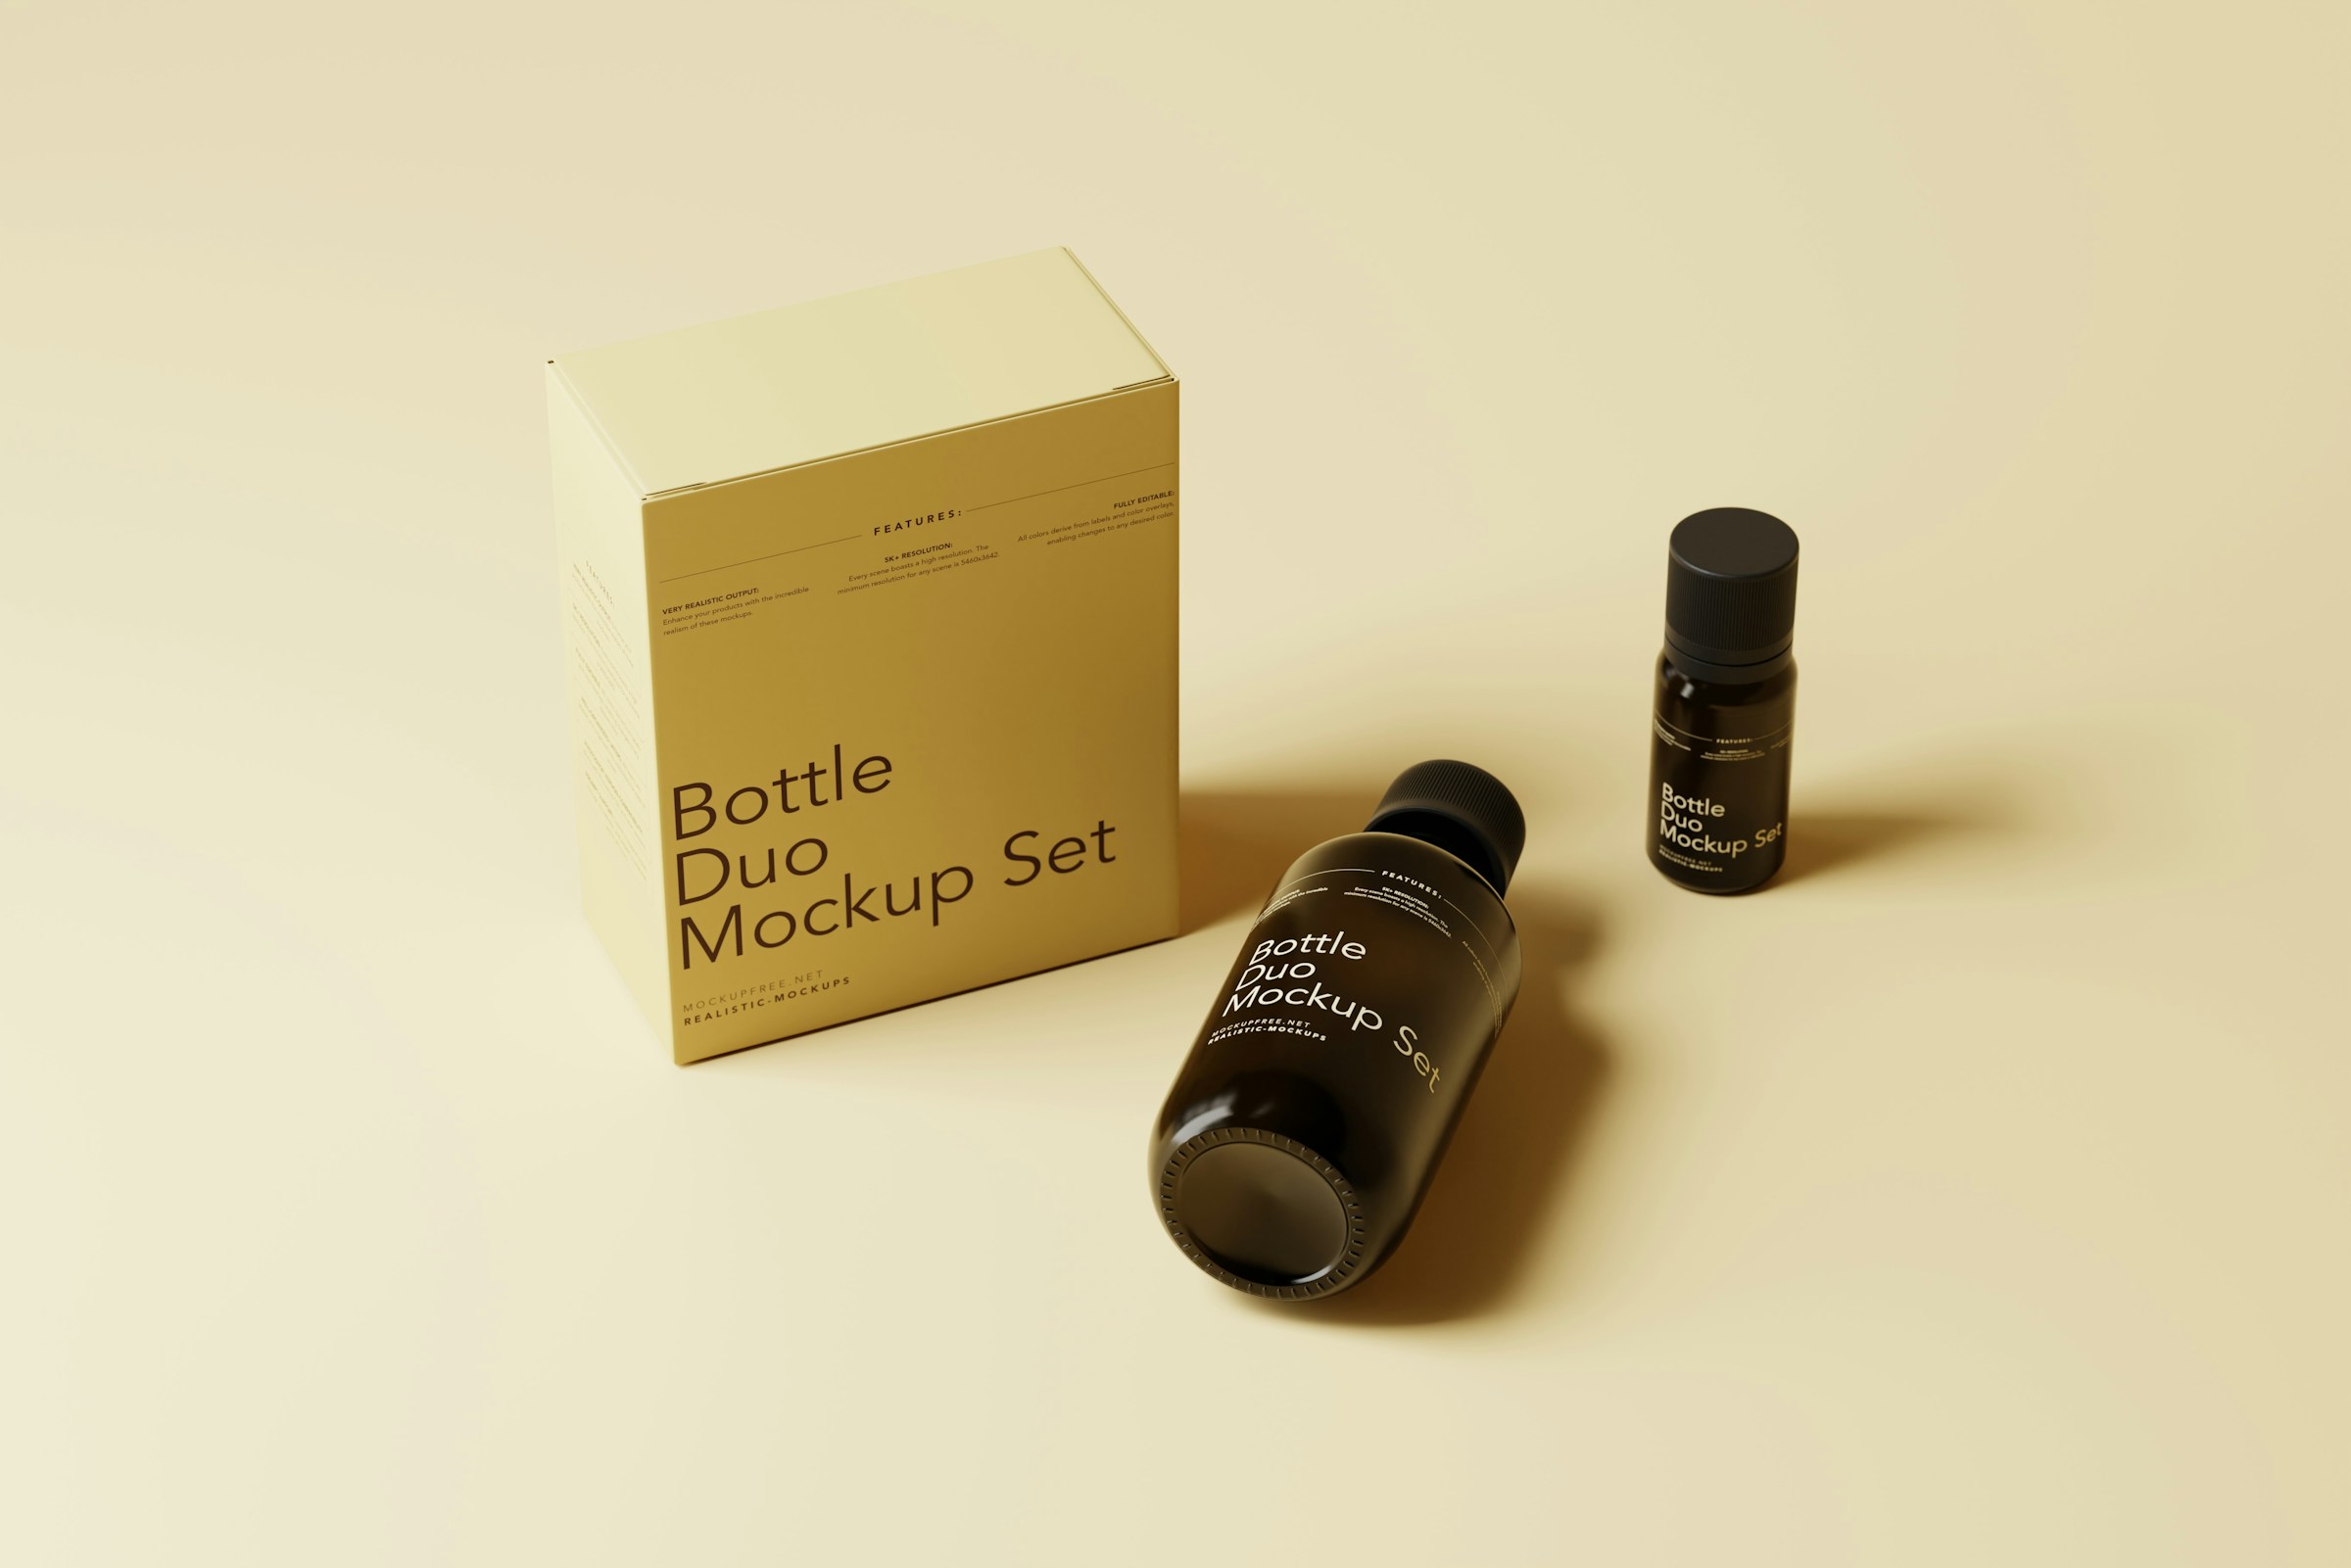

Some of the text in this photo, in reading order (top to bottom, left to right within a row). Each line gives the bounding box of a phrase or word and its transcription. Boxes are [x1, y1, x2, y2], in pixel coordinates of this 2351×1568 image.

[1114, 490, 1175, 509] FULLY EDITABLE:
[874, 509, 962, 536] FEATURES:
[1029, 530, 1049, 541] colors
[1051, 525, 1072, 535] derive
[1074, 521, 1089, 530] from
[1091, 515, 1111, 526] labels
[1127, 508, 1144, 517] color
[1046, 534, 1077, 546] enabling
[1078, 528, 1106, 539] changes
[1129, 515, 1155, 526] desired
[901, 543, 953, 559] RESOLUTION:
[838, 583, 870, 594] minimum
[871, 575, 905, 587] resolution
[918, 568, 931, 577] any
[933, 564, 952, 573] scene
[848, 573, 868, 583] Every
[869, 568, 889, 578] scene
[890, 562, 914, 573] boasts
[921, 556, 936, 565] high
[662, 588, 759, 615] VERY REALISTIC OUTPUT:
[663, 587, 809, 626] Enhance your products with the incredible
[663, 625, 689, 636] realism
[699, 619, 719, 628] these
[673, 743, 892, 841] Bottle
[1662, 782, 1725, 818] Bottle
[1661, 800, 1703, 832] Duo
[1660, 818, 1782, 859] Mockup Set
[676, 837, 828, 906] Duo
[1382, 870, 1442, 899] FEATURES:
[680, 820, 1116, 971] Mockup Set
[1249, 930, 1367, 967] Bottle
[683, 970, 823, 1013] MOCKUPFREE.NET
[1235, 962, 1316, 992] Duo
[684, 976, 849, 1025] REALISTIC-MOCKUPS
[1208, 1025, 1326, 1045] REALISTIC-MOCKUPS
[1212, 1019, 1311, 1037] MOCKUPFREE.NET
[1223, 981, 1440, 1094] Mockup Set
